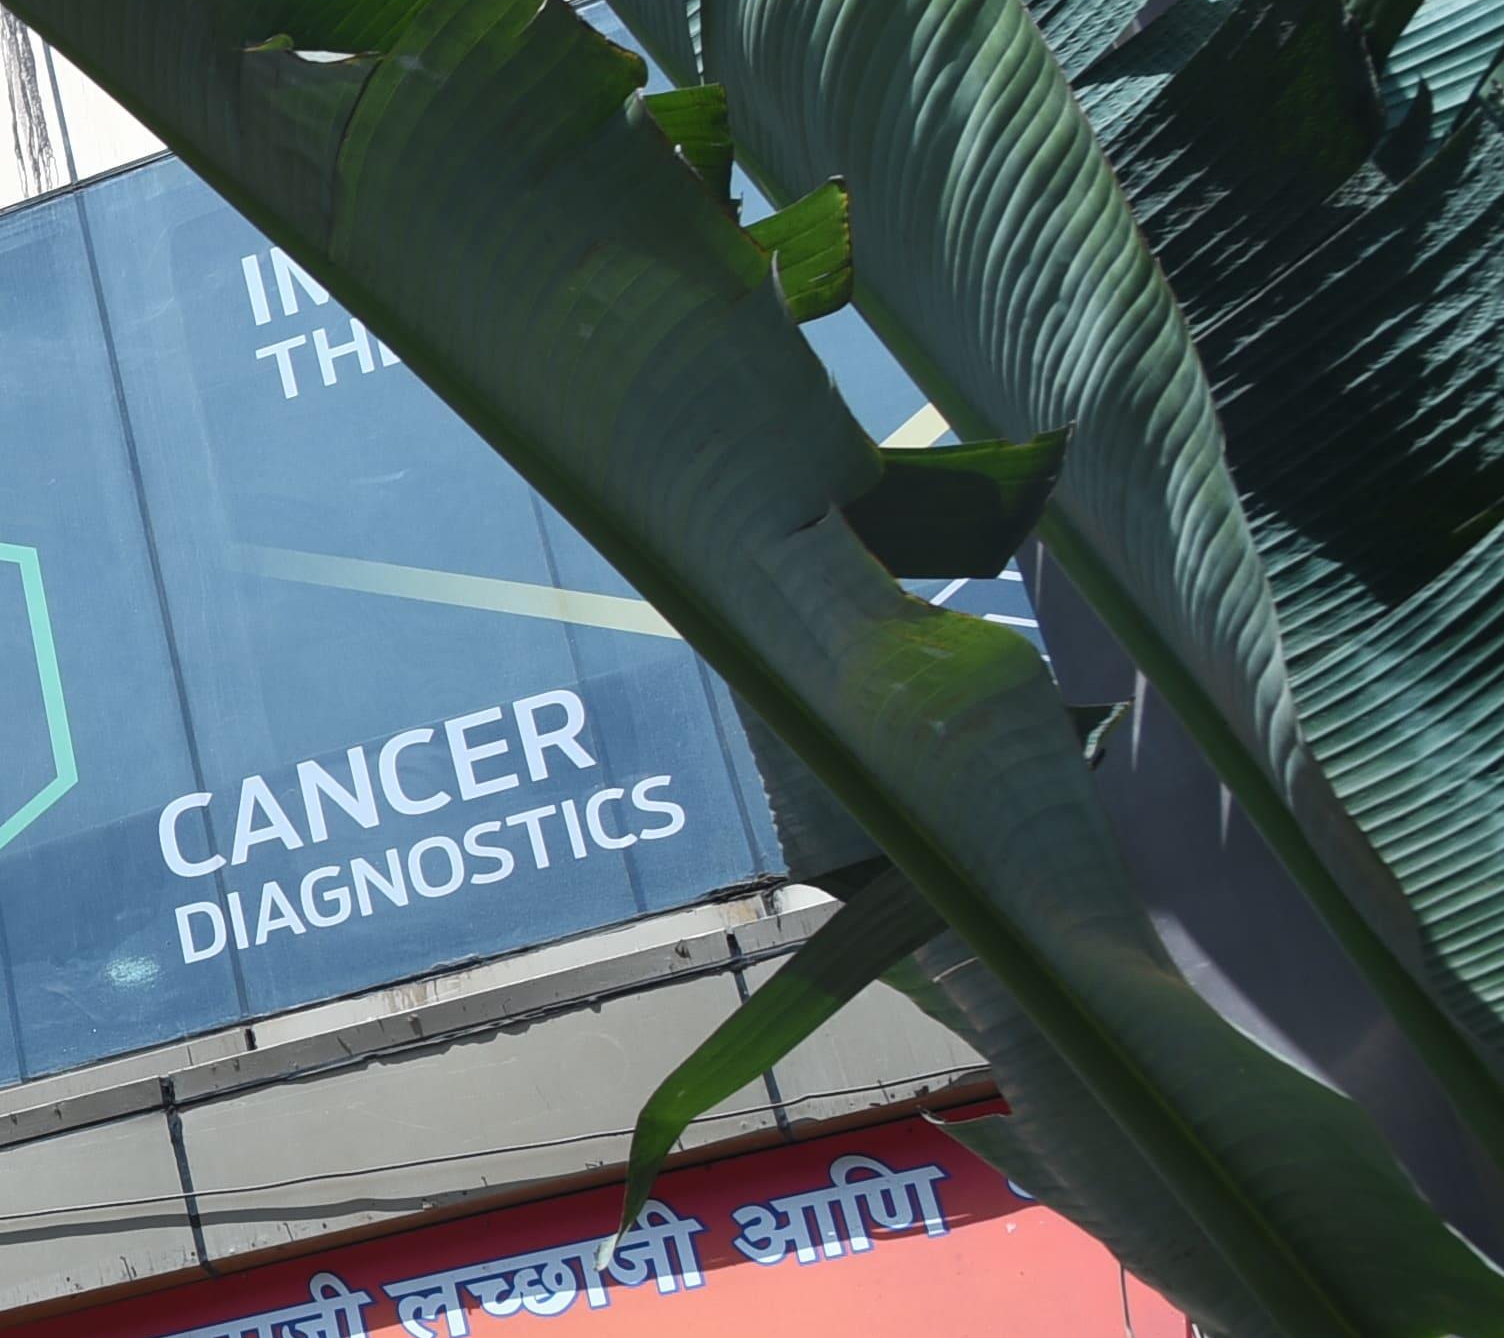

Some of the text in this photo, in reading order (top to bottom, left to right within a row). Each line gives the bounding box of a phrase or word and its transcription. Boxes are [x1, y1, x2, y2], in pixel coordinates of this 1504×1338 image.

[157, 688, 597, 878] CANCER
[175, 772, 686, 966] DIAGNOSTICS
[731, 1154, 951, 1268] आणि
